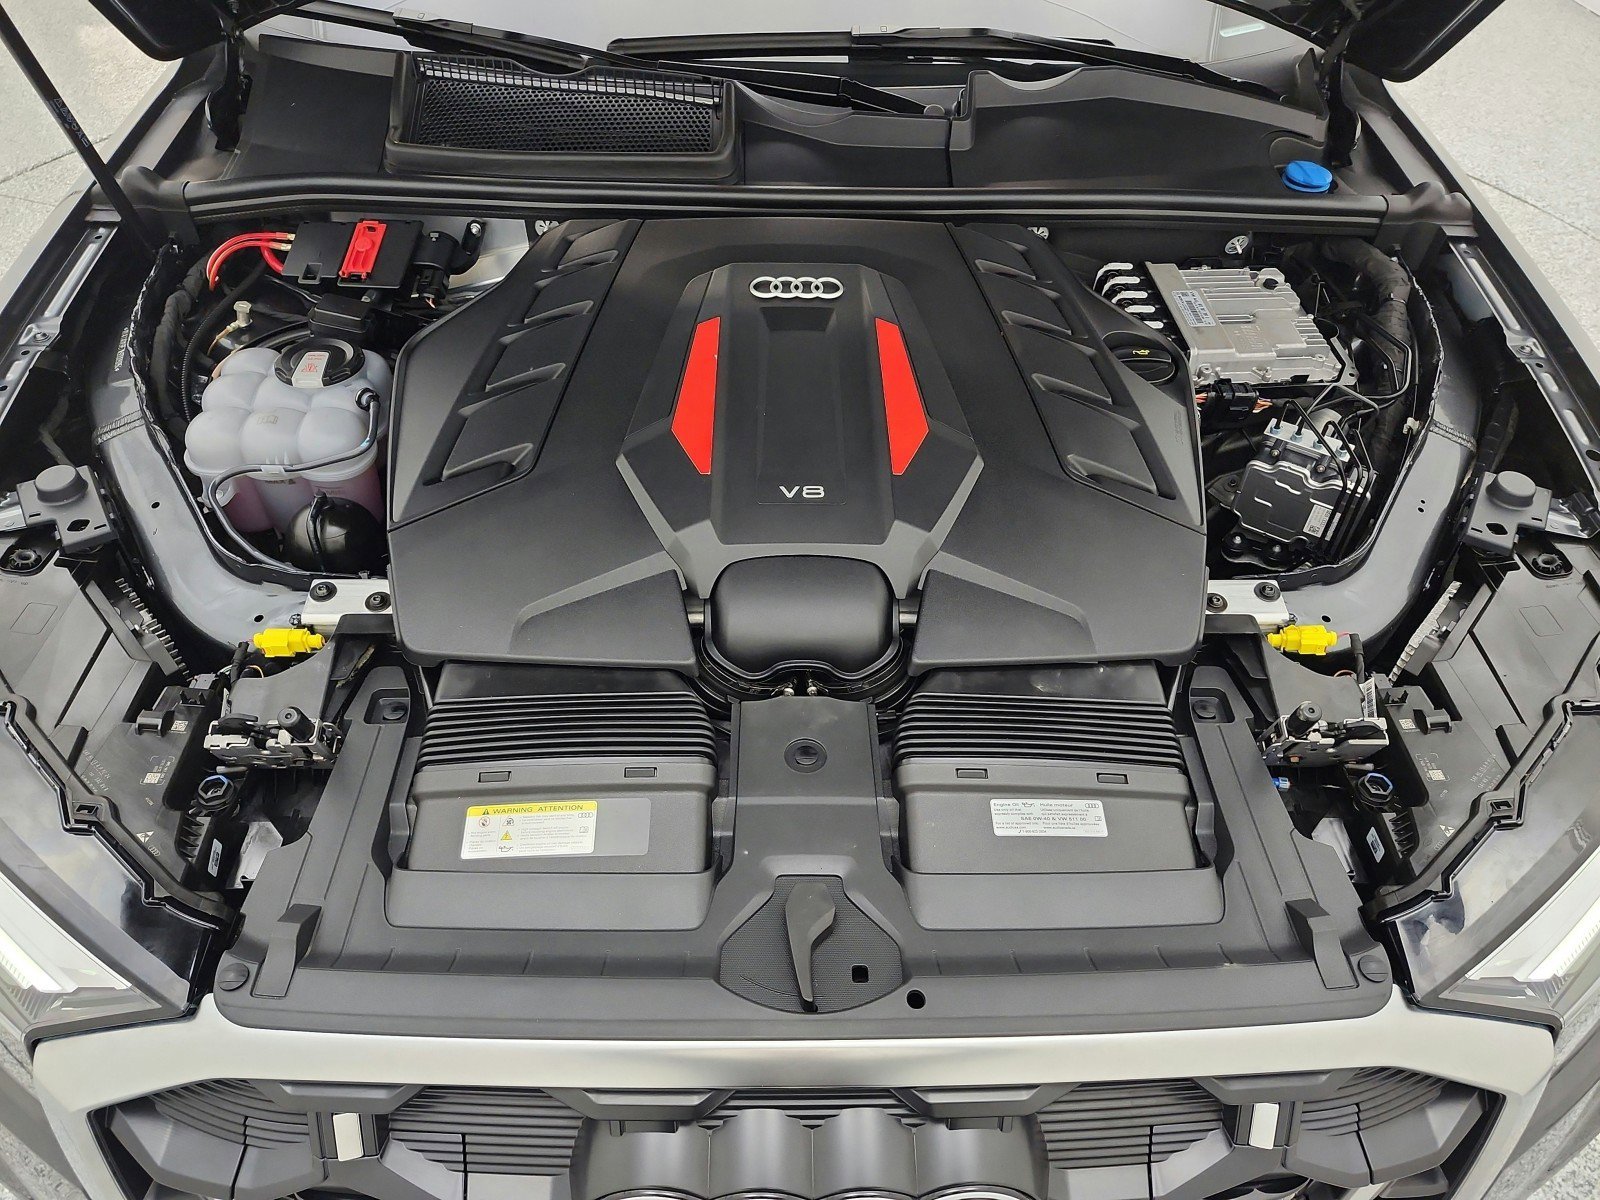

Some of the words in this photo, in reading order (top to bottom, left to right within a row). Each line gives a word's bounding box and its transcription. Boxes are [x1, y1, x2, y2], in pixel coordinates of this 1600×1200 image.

[779, 485, 825, 498] V8
[492, 807, 533, 815] WARNING
[537, 804, 584, 812] ATTENTION
